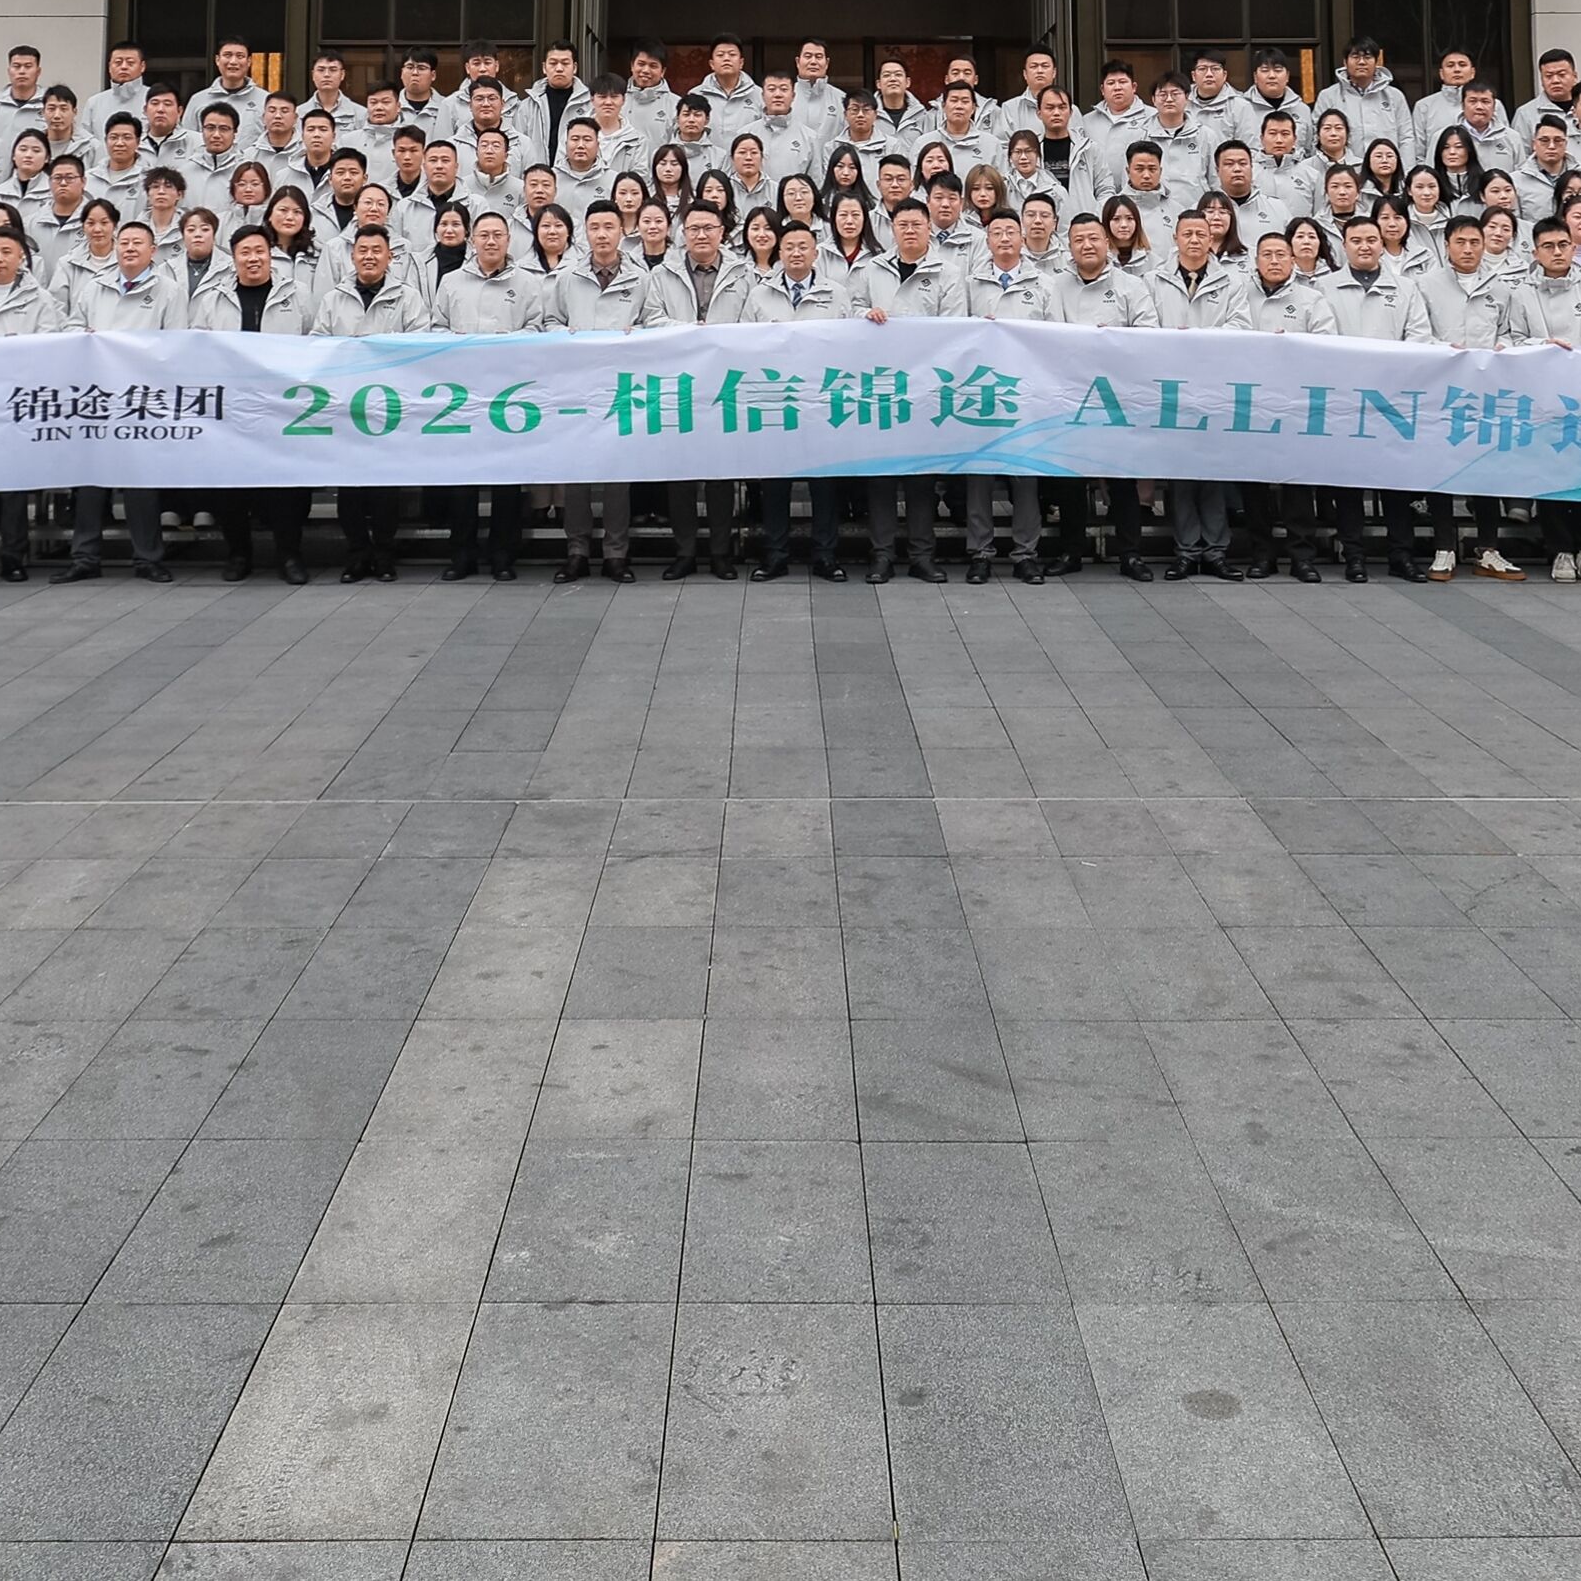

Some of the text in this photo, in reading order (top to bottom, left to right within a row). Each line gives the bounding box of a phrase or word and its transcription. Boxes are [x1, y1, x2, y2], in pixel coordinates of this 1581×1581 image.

[6, 383, 226, 423] 锦途集团
[31, 425, 204, 442] JIN TU GROUP
